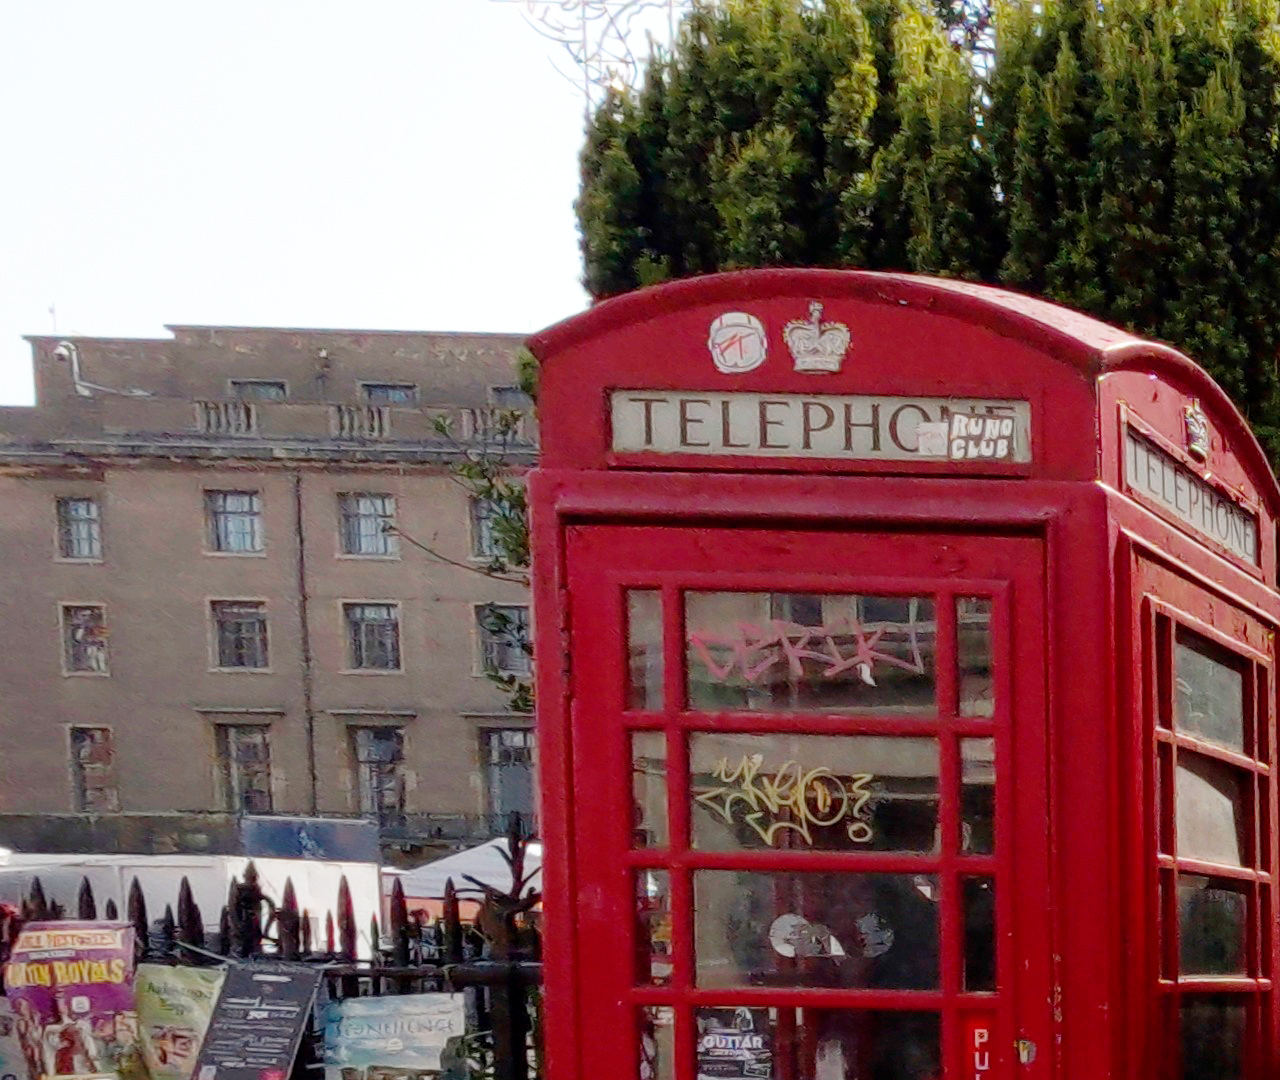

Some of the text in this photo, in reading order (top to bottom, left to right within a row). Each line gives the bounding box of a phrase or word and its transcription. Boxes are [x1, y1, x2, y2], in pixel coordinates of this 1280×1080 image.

[627, 397, 1018, 453] TELEPHO
[951, 438, 1009, 460] CLUB
[1128, 432, 1255, 558] TELEPHONE
